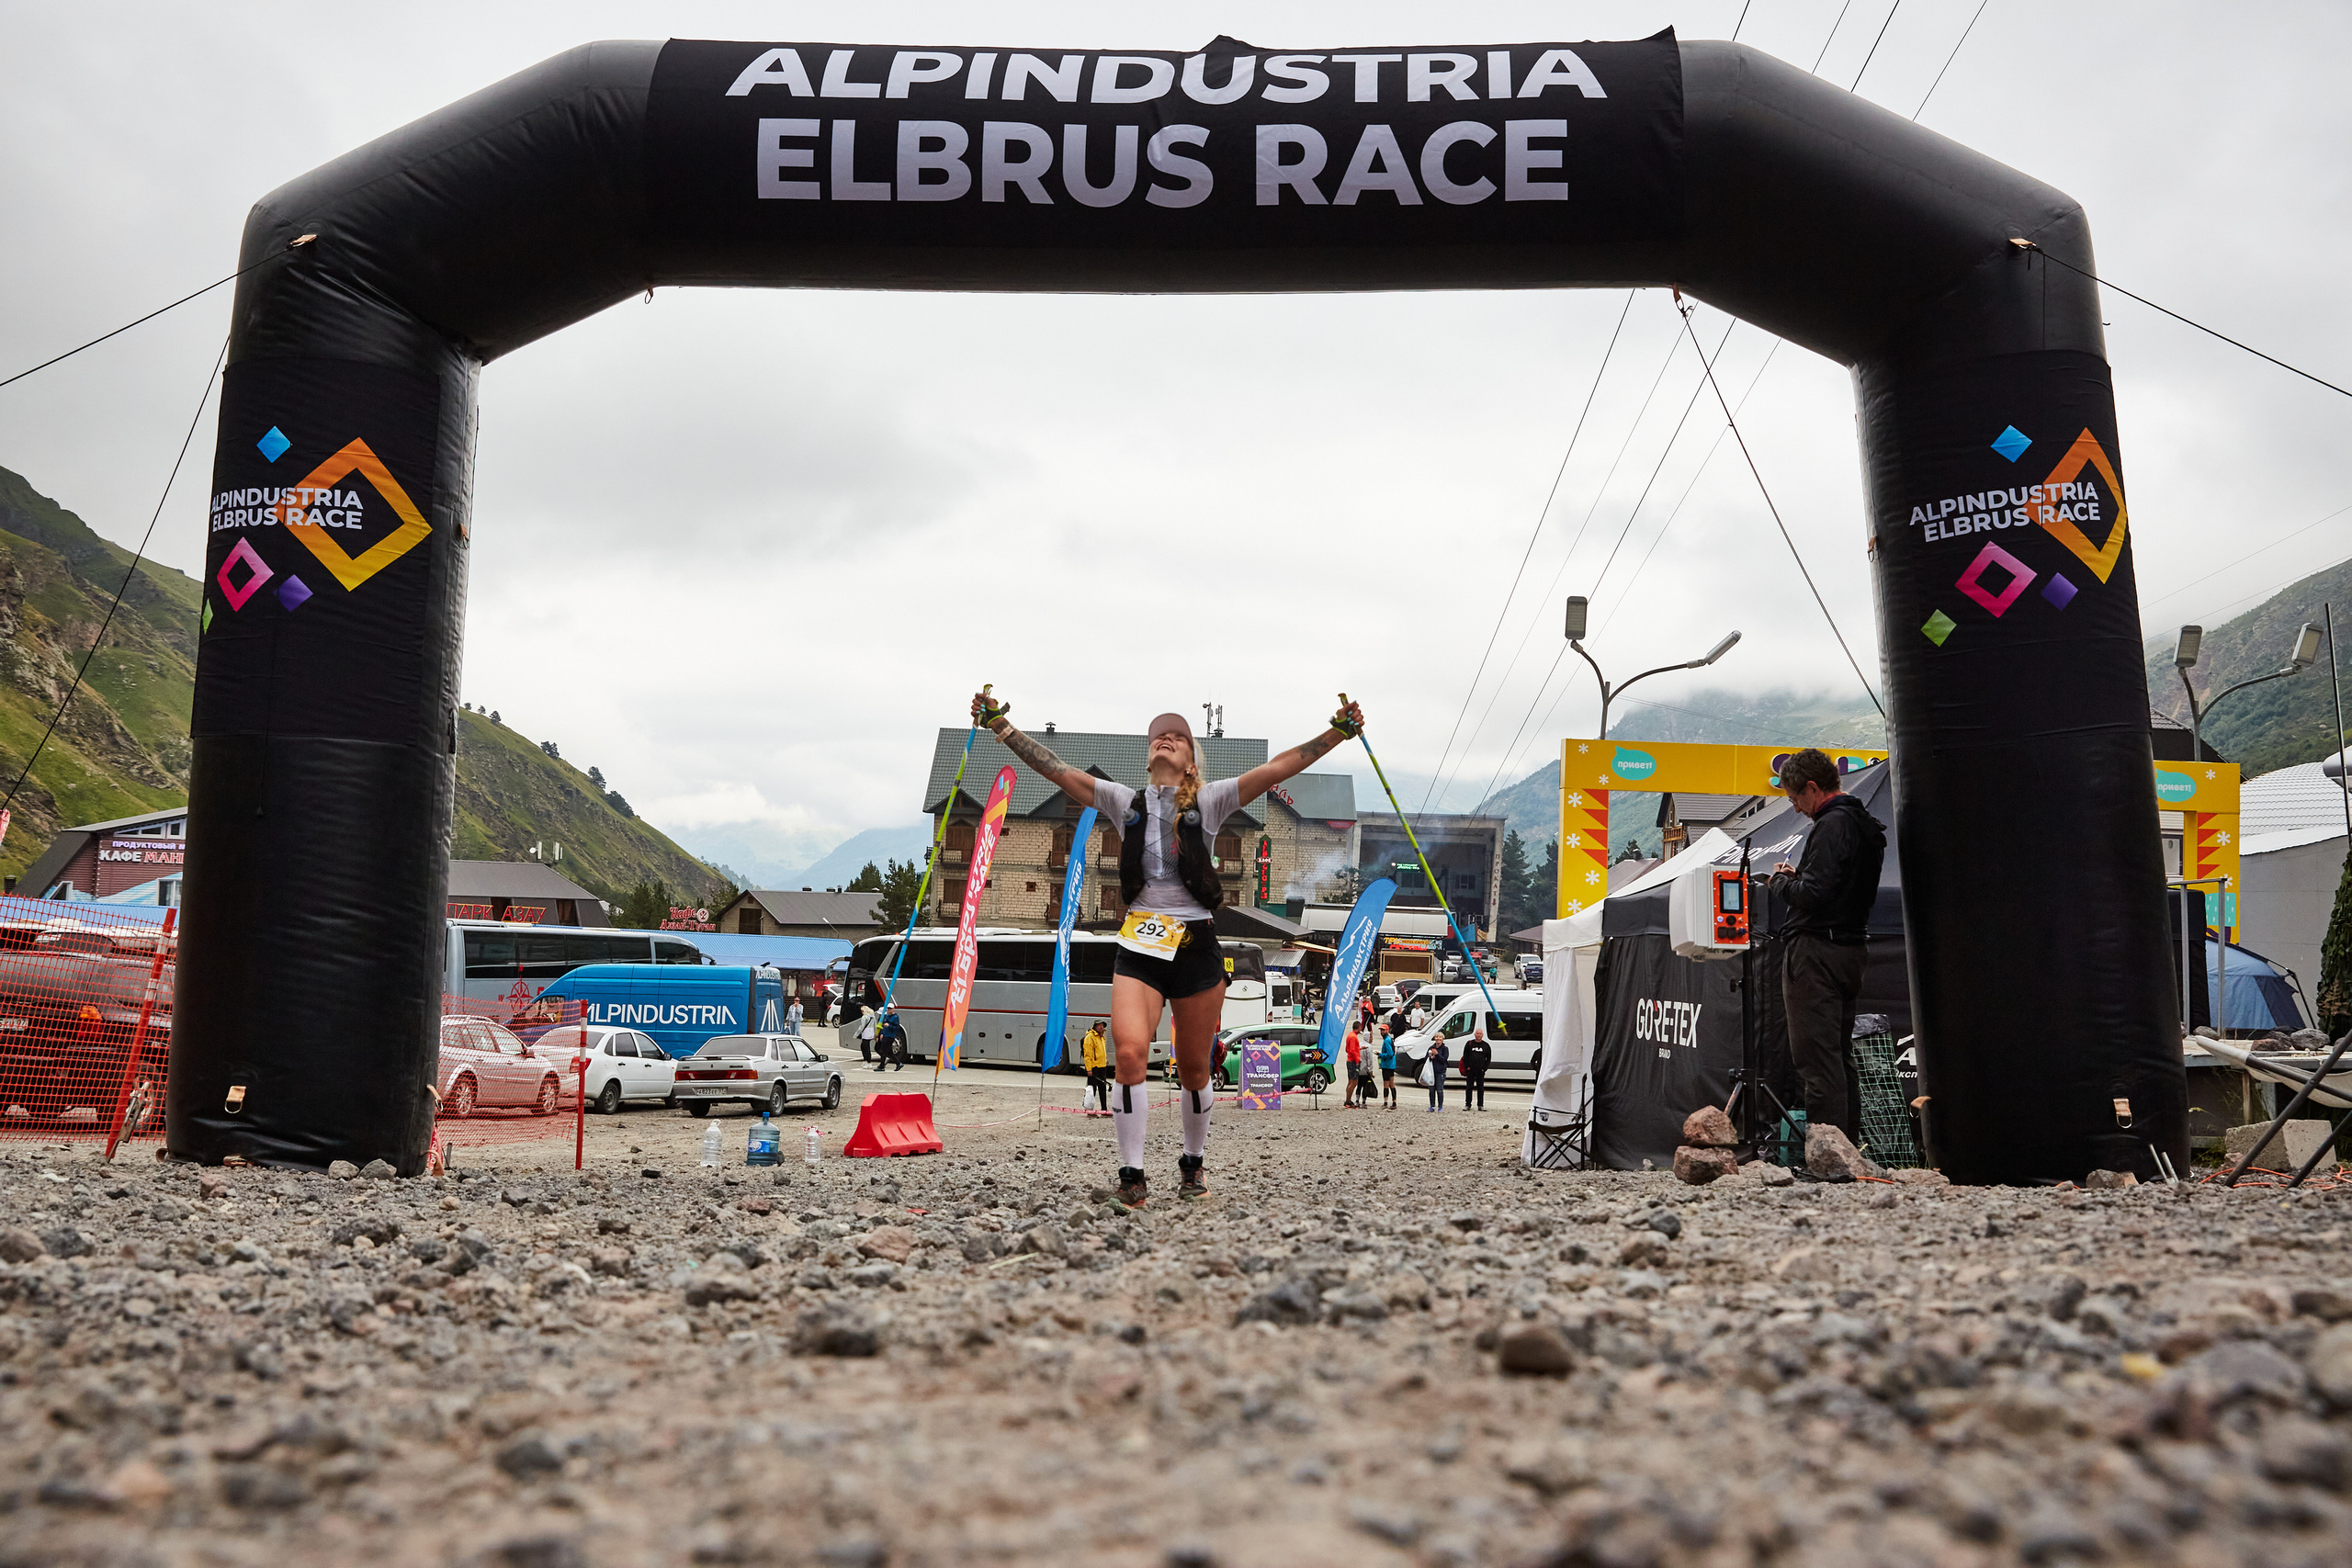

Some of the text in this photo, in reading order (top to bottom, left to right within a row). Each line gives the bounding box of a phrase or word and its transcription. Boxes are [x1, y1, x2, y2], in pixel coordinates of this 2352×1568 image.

[725, 48, 1608, 105] ALPINDUSTRIA
[756, 118, 1568, 209] ELBRUS RACE
[210, 487, 364, 514] ALPINDUSTRIA
[1909, 481, 2099, 526] ALPINDUSTRIA
[212, 507, 363, 533] ELBRUS RACE
[1923, 502, 2101, 543] ELBRUS RACE
[1617, 761, 1653, 771] привет!
[2157, 784, 2191, 793] привет!
[112, 840, 176, 850] ПРОДУКТОВЫЙ
[99, 850, 142, 863] КАФЕ
[447, 903, 547, 924] ПАРК АЗАУ
[670, 906, 696, 922] Кафе
[1136, 921, 1166, 938] 292
[586, 1003, 738, 1025] ALPINDUSTRIA
[1636, 998, 1702, 1048] GORE-TEX
